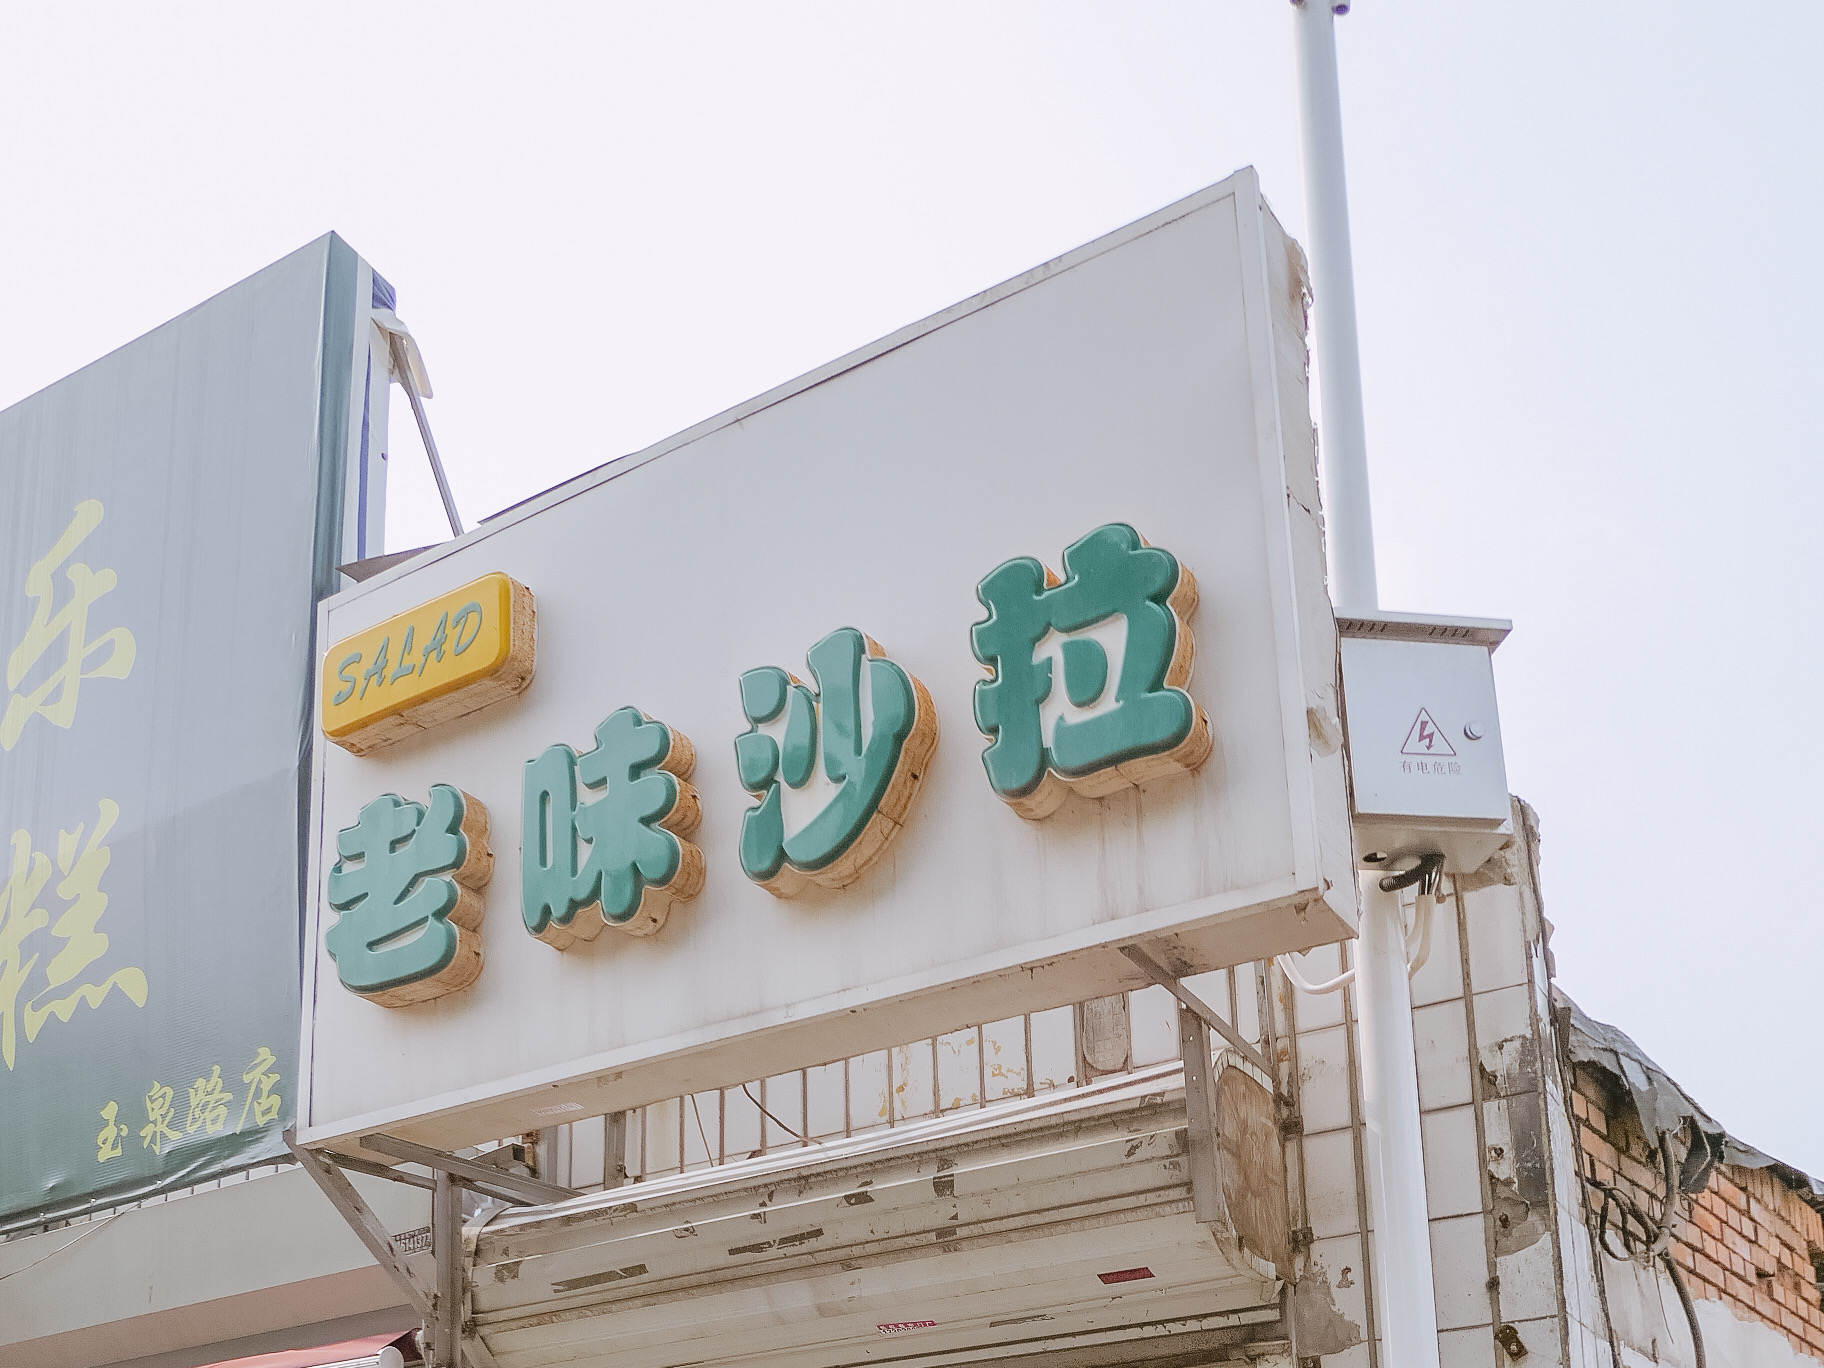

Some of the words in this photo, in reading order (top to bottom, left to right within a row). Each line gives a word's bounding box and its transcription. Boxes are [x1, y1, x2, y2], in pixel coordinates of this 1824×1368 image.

[333, 601, 483, 706] SALAD
[325, 522, 1198, 993] 老味沙拉
[0, 798, 148, 1070] 糕
[97, 1046, 282, 1162] 玉泉路店
